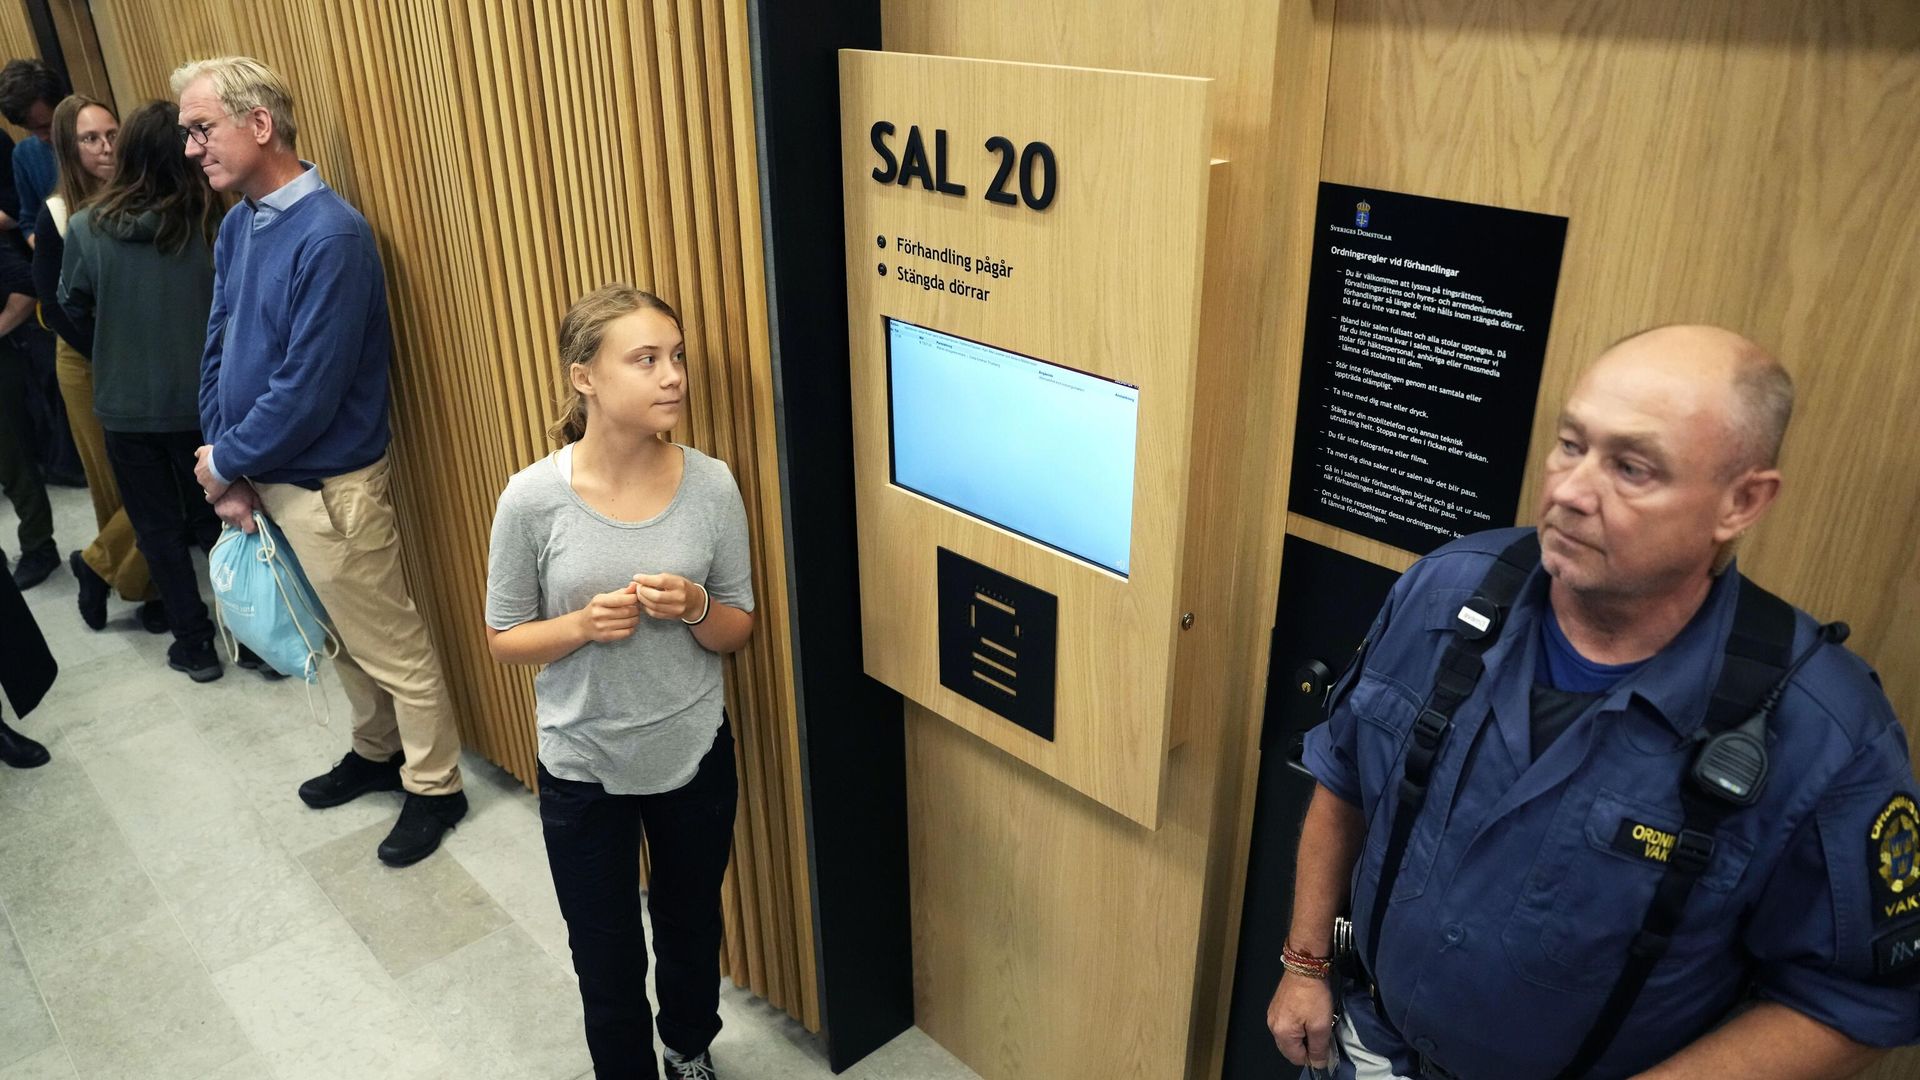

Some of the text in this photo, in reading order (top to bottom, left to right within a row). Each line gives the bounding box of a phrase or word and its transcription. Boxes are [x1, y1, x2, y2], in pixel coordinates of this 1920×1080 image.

[870, 121, 1057, 211] SAL 20
[897, 237, 1013, 279] Förhandling pågår
[1331, 246, 1459, 277] Ordningsregler vid förhandlingar
[897, 266, 990, 302] Stängda dörrar
[1344, 278, 1402, 296] förvaltningsrättens
[1416, 292, 1437, 302] hyres-
[1438, 298, 1450, 306] och
[1451, 301, 1512, 318] arrendenämndens
[1363, 273, 1398, 285] välkommen
[1411, 281, 1430, 292] lyssna
[1432, 286, 1440, 294] på
[1442, 288, 1484, 303] tingsrättens,
[1344, 288, 1524, 331] förhandlingar så länge de inte hålls inom stängda dörrar.
[1372, 303, 1384, 312] inte
[1385, 307, 1399, 315] vara
[1400, 310, 1416, 319] med.
[1338, 335, 1356, 343] stolar
[1367, 340, 1415, 358] häktespersonal,
[1417, 353, 1444, 365] anhöriga
[1446, 359, 1462, 368] eller
[1463, 364, 1500, 377] massmedia
[1340, 316, 1359, 325] Ibland
[1360, 320, 1371, 328] blir
[1372, 324, 1388, 332] salen
[1390, 326, 1412, 337] fullsatt
[1427, 335, 1439, 343] alla
[1441, 339, 1460, 348] stolar
[1461, 343, 1494, 356] upptagna.
[1497, 350, 1506, 358] Då
[1340, 324, 1348, 332] får
[1359, 329, 1371, 337] inte
[1372, 333, 1393, 342] stanna
[1394, 337, 1408, 346] kvar
[1413, 342, 1432, 351] salen.
[1434, 346, 1455, 356] Ibland
[1456, 352, 1491, 364] reserverar
[1342, 344, 1360, 354] lämna
[1370, 352, 1395, 362] stolarna
[1407, 359, 1423, 369] dem.
[1334, 371, 1392, 390] uppträda olämpligt.
[1336, 360, 1482, 402] Stör inte förhandlingen genom att samtala eller
[1342, 390, 1353, 398] inte
[1354, 394, 1368, 402] med
[1369, 397, 1378, 406] dig
[1379, 400, 1392, 408] mat
[1393, 404, 1408, 412] eller
[1409, 408, 1428, 418] dryck.
[1330, 415, 1359, 428] utrustning
[1360, 422, 1374, 431] helt.
[1376, 426, 1396, 437] Stoppa
[1410, 436, 1422, 444] den
[1427, 440, 1446, 451] fickan
[1448, 447, 1463, 455] eller
[1464, 451, 1488, 463] väskan.
[1331, 404, 1347, 416] Stäng
[1367, 416, 1405, 430] mobiltelefon
[1406, 426, 1418, 434] och
[1419, 430, 1438, 439] annan
[1440, 435, 1463, 446] teknisk
[1328, 430, 1336, 438] Du
[1347, 436, 1359, 444] inte
[1360, 440, 1393, 454] fotografera
[1394, 450, 1409, 458] eller
[1410, 454, 1428, 464] filma.
[1324, 464, 1332, 472] Gå
[1344, 471, 1359, 480] salen
[1371, 478, 1412, 496] förhandlingen
[1413, 491, 1433, 502] börjar
[1473, 511, 1490, 520] salen
[1326, 447, 1333, 455] Ta
[1334, 451, 1347, 459] med
[1348, 455, 1358, 463] dig
[1358, 458, 1371, 466] dina
[1373, 462, 1389, 471] saker
[1406, 472, 1422, 481] salen
[1435, 480, 1446, 488] det
[1448, 483, 1459, 492] blir
[1460, 488, 1477, 498] paus.
[1321, 489, 1331, 497] Om
[1341, 495, 1353, 504] inte
[1354, 500, 1387, 514] respekterar
[1388, 511, 1404, 521] dessa
[1406, 517, 1451, 536] ordningsregler,
[1328, 499, 1345, 510] lämna
[1346, 505, 1387, 524] förhandlingen.
[1334, 476, 1373, 493] förhandlingen
[1374, 489, 1392, 498] slutar
[1416, 502, 1427, 510] det
[1428, 505, 1440, 513] blir
[1440, 510, 1457, 519] paus.
[1632, 824, 1677, 849] ORDNI
[1645, 843, 1671, 862] VAK
[1885, 893, 1920, 916] VAK
